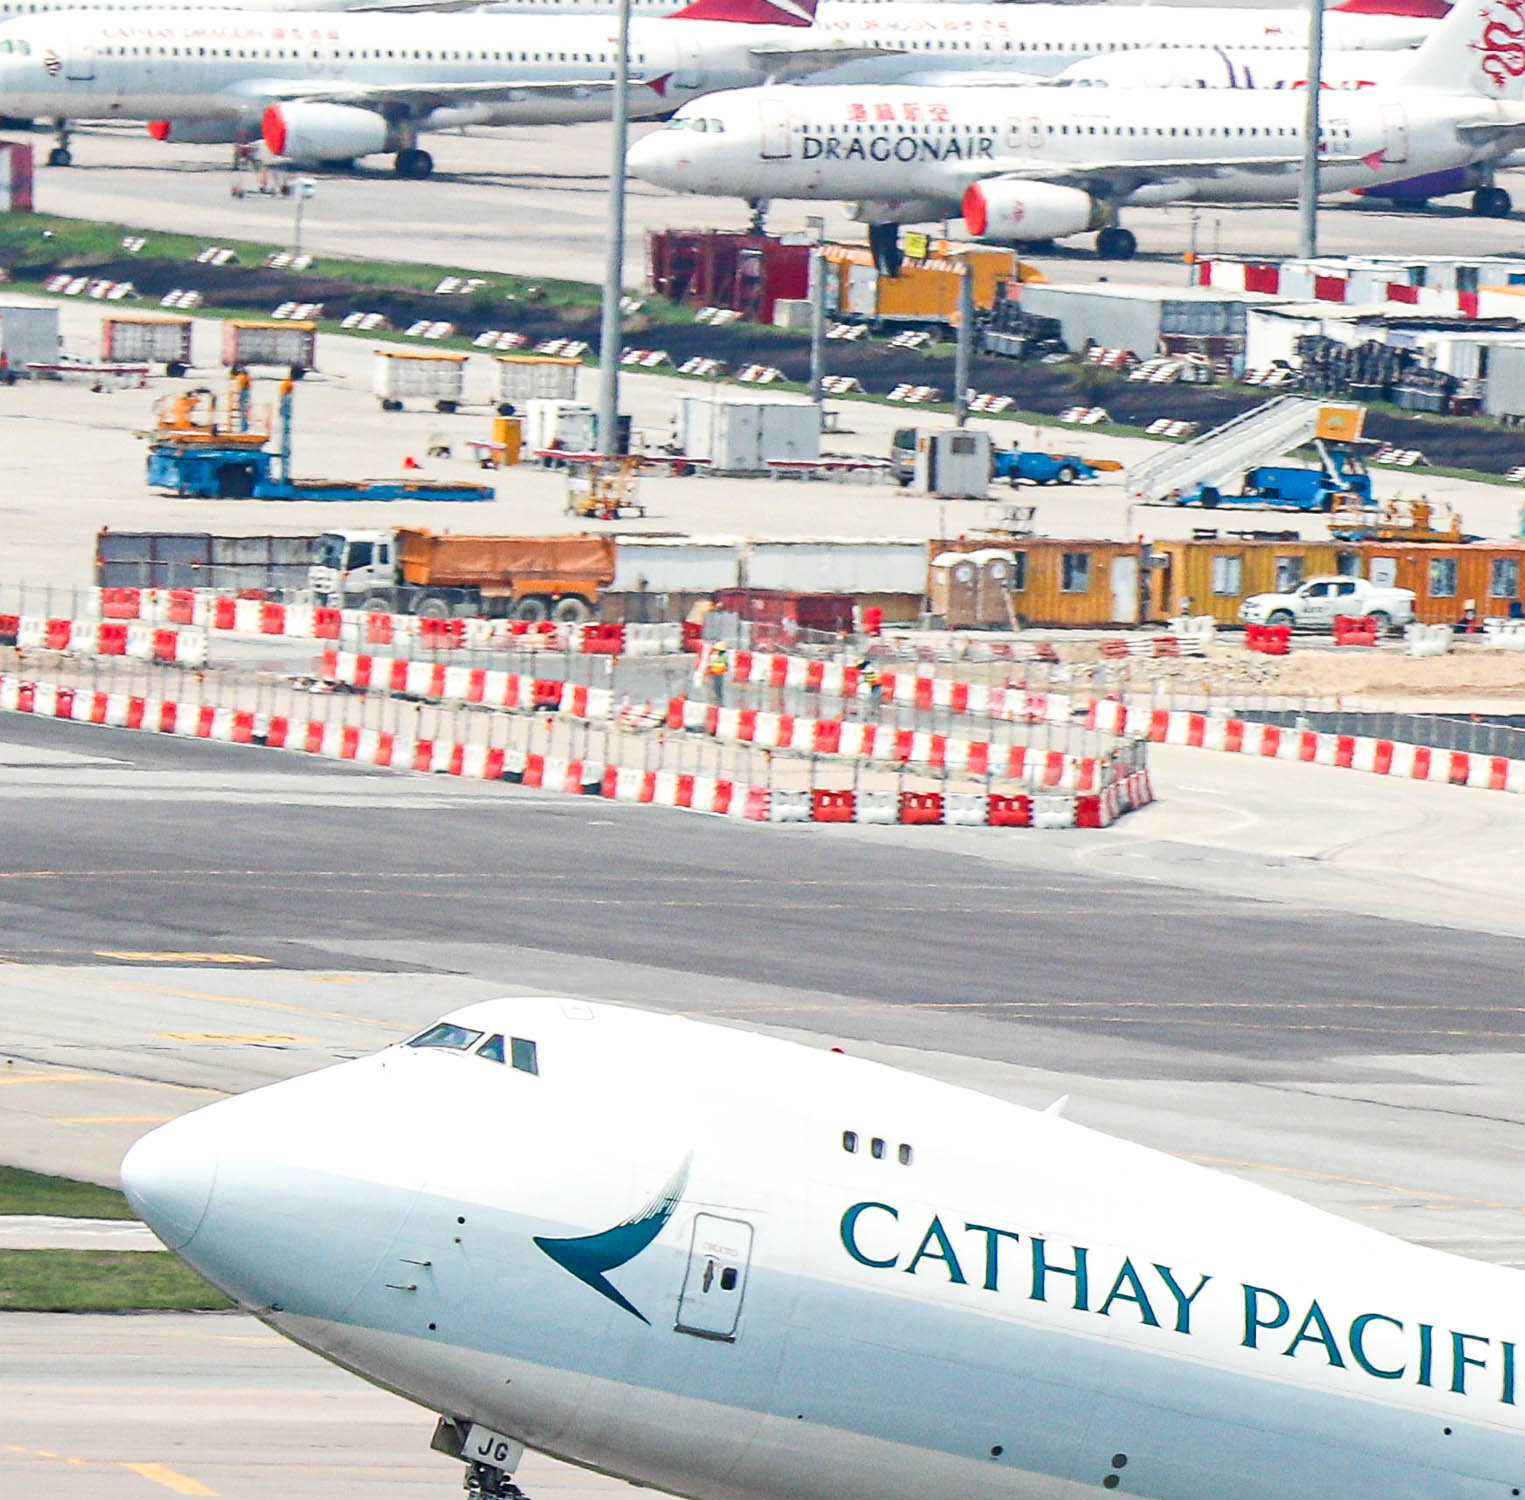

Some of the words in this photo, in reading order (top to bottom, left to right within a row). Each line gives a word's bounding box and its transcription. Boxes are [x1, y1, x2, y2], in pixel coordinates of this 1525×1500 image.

[801, 136, 996, 162] DRAGONAIR
[839, 1201, 1214, 1336] CATHAY
[478, 1437, 509, 1462] JG
